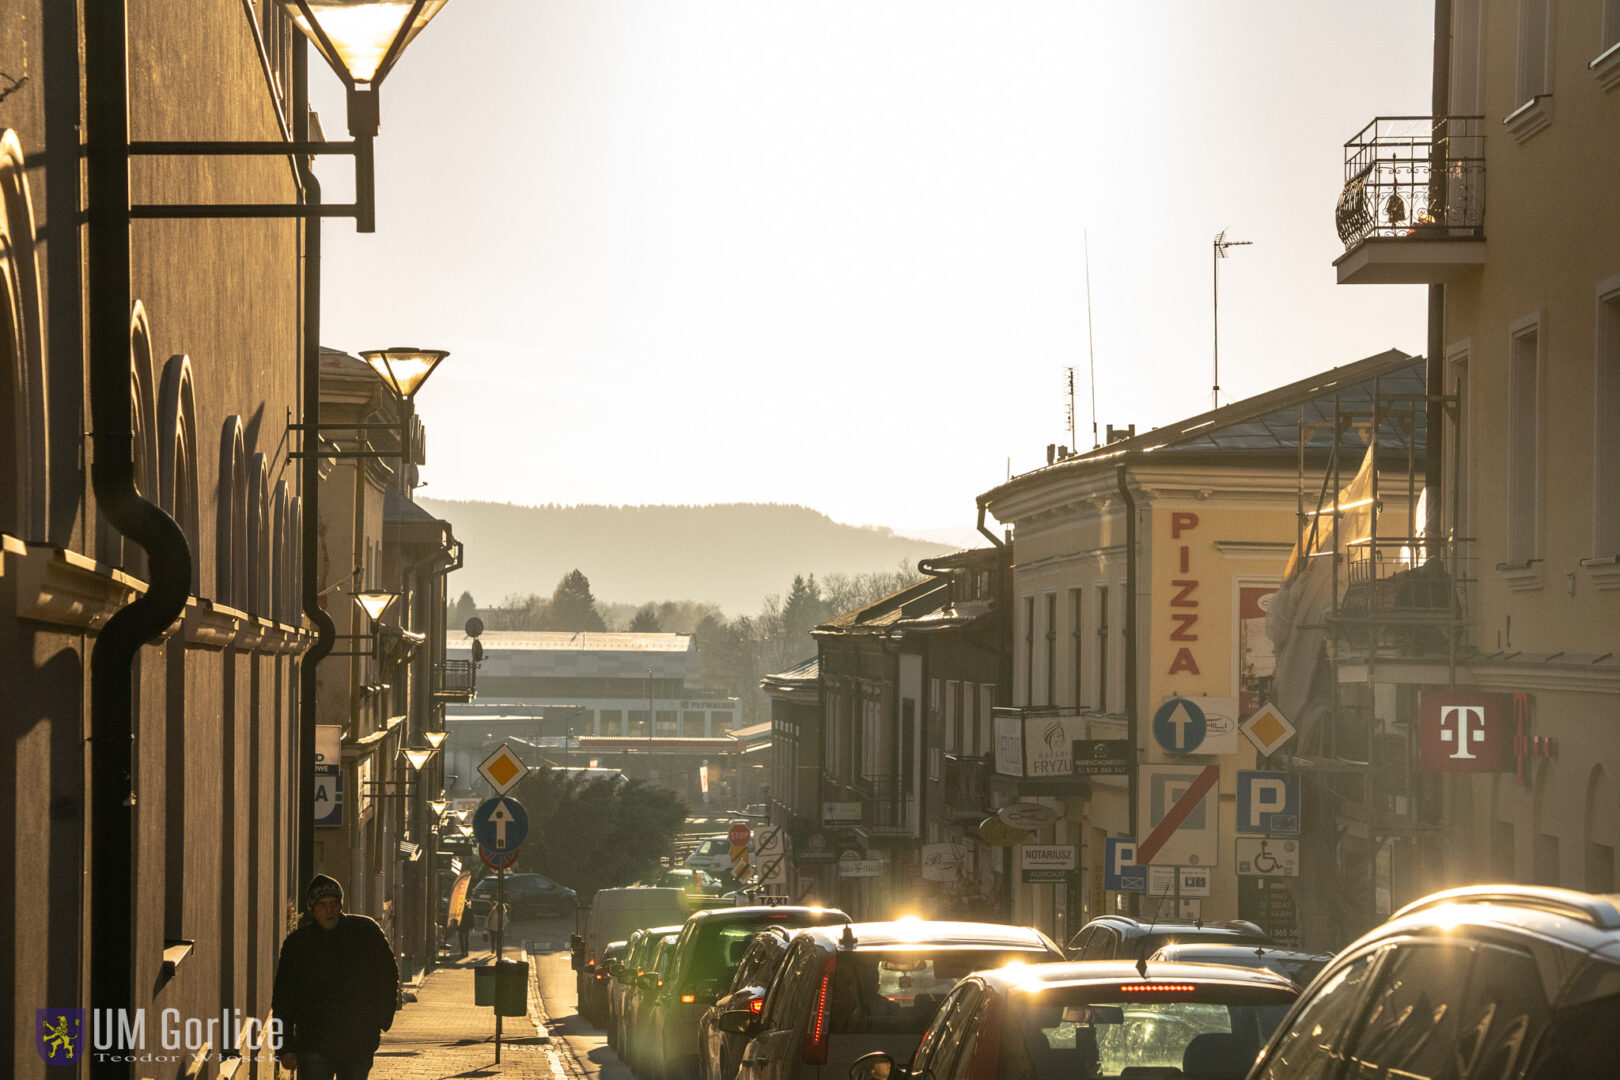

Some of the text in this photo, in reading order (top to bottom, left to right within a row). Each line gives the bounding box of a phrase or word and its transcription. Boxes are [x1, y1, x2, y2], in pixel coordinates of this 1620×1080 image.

[1168, 512, 1200, 675] PIZZA
[1440, 705, 1485, 759] T
[1034, 759, 1073, 774] FRYZU
[315, 785, 328, 801] A
[1250, 778, 1287, 827] P
[729, 832, 749, 840] STOP
[1025, 849, 1072, 860] NOTARIUSZ
[1114, 842, 1137, 875] P
[759, 897, 788, 905] TAXI
